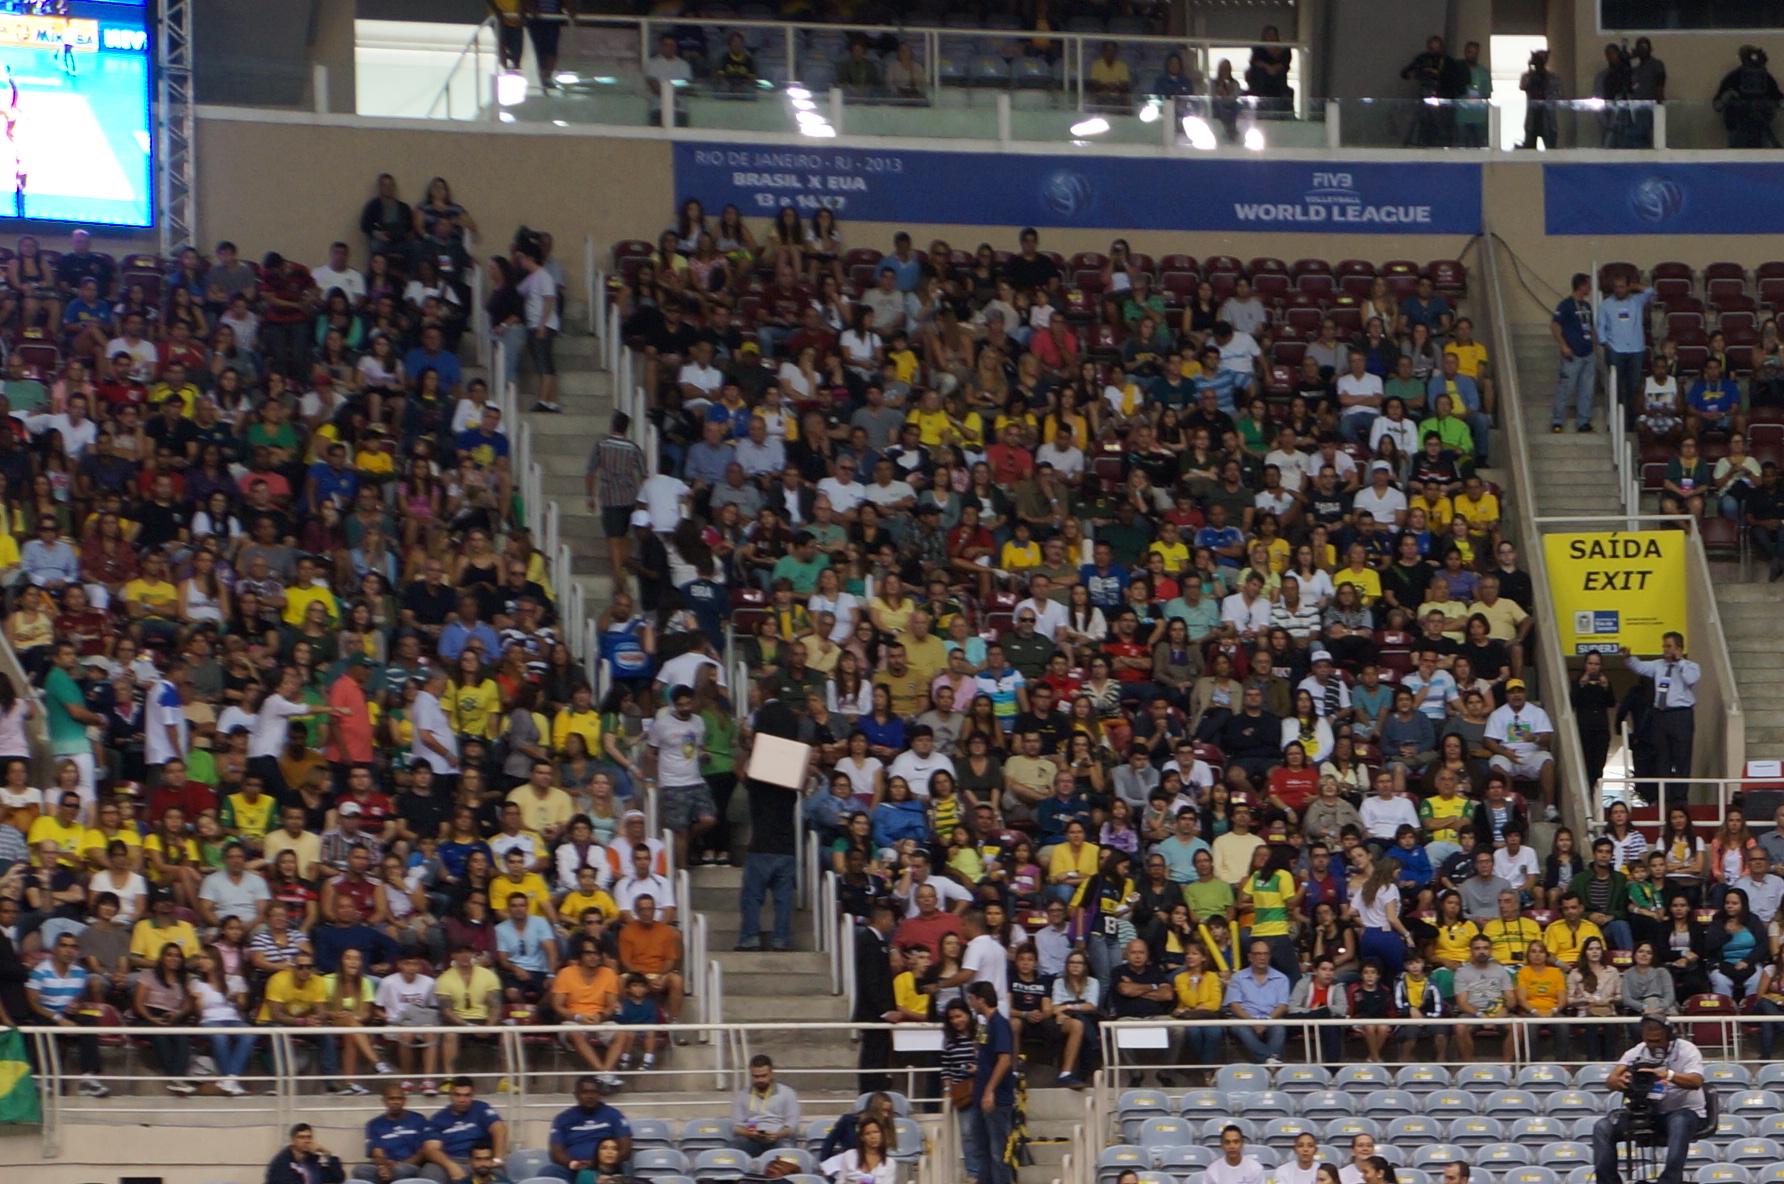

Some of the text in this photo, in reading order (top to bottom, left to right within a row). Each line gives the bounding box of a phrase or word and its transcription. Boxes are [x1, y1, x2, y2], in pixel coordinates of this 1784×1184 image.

[37, 30, 93, 44] MIKSA
[695, 151, 724, 166] RIO
[728, 152, 750, 166] DE
[754, 153, 822, 169] JANEIRO
[865, 157, 903, 172] 2013
[733, 172, 867, 191] BRASIL X EUA
[1312, 172, 1354, 188] FIVB
[1234, 203, 1432, 222] WORLD LEAGUE
[1569, 532, 1663, 559] SAÍDA
[1583, 570, 1654, 591] EXIT
